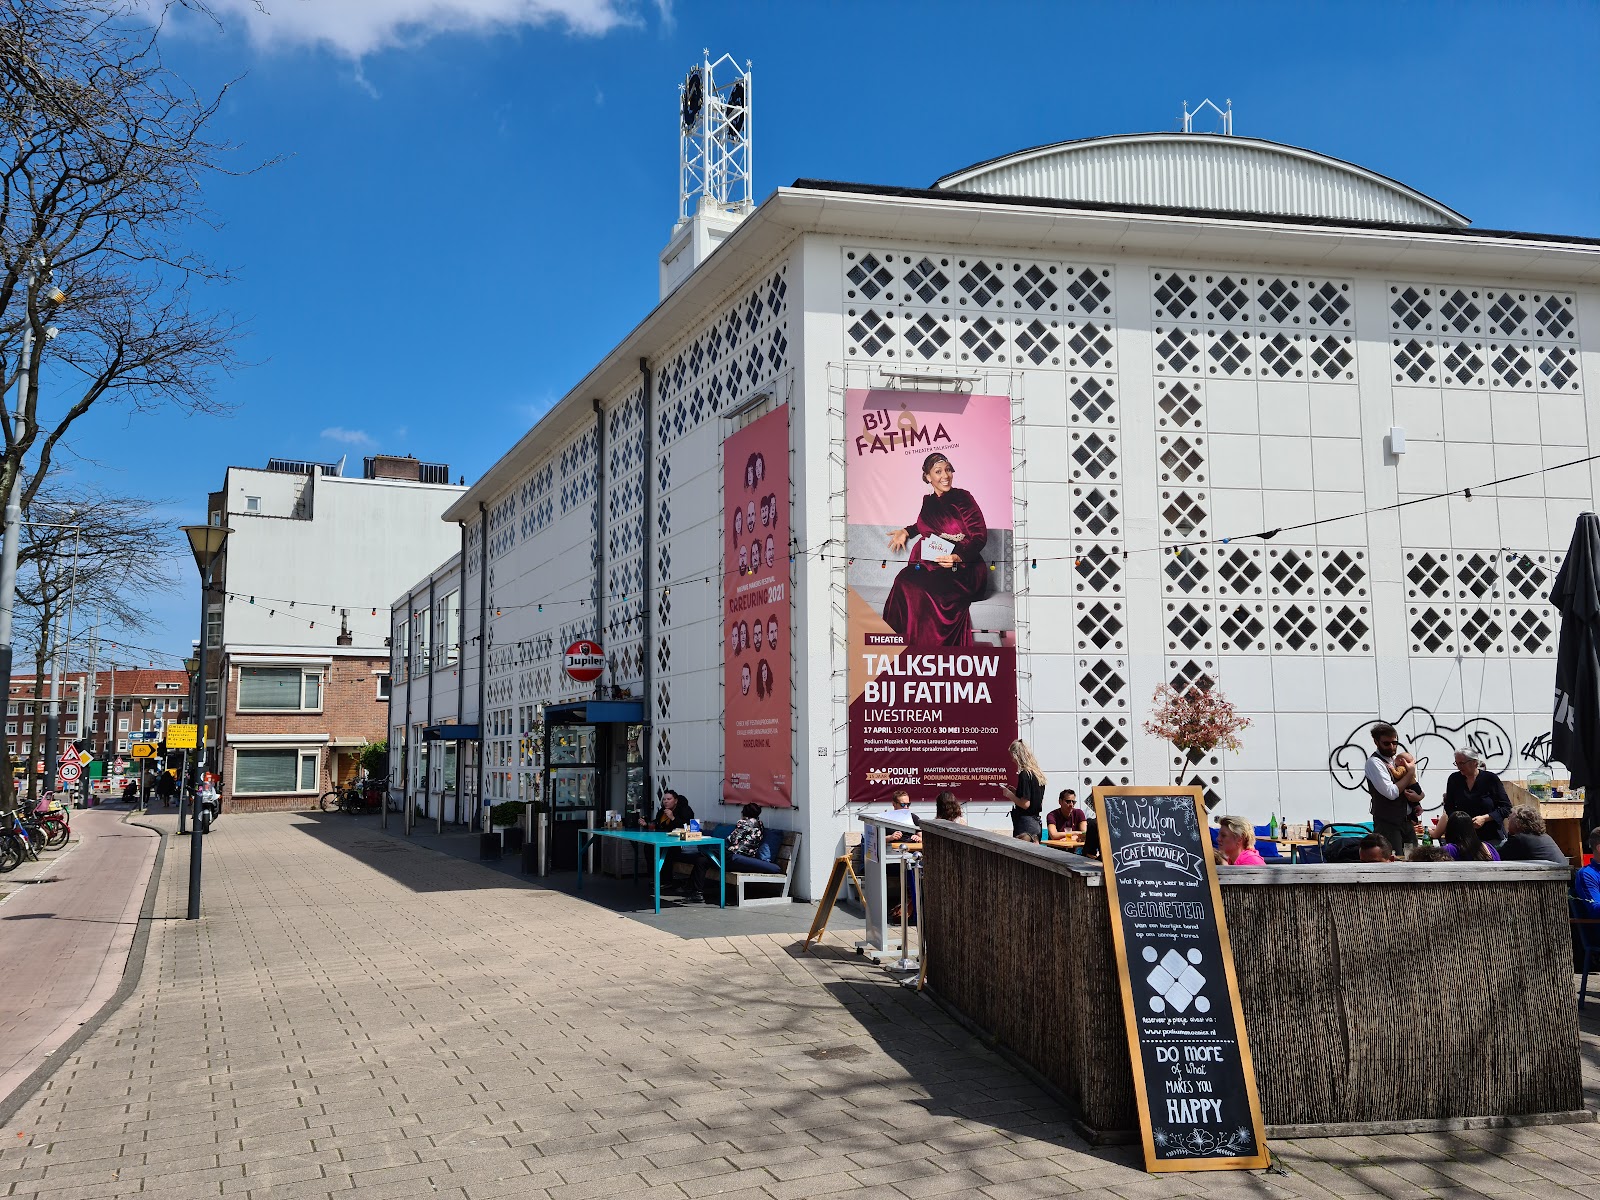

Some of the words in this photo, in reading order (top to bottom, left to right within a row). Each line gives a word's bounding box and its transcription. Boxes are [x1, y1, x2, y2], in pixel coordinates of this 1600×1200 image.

[863, 409, 891, 430] BIJ
[856, 422, 952, 456] FATIMA
[870, 636, 904, 644] THEATER
[567, 656, 603, 667] Jupiler
[863, 654, 999, 677] TALKSHOW
[864, 681, 896, 706] BIJ
[904, 682, 992, 704] FATIMA
[864, 709, 942, 722] LIVESTREAM
[63, 767, 77, 775] 30
[1122, 798, 1181, 836] Welkom
[1123, 843, 1147, 860] CAFÉ
[1148, 845, 1185, 864] MOZAÏEK
[1156, 1046, 1180, 1063] DO
[1171, 1062, 1182, 1081] of
[1165, 1080, 1193, 1094] MAKES
[1196, 1080, 1213, 1093] YOU
[1166, 1098, 1223, 1124] HAPPY
